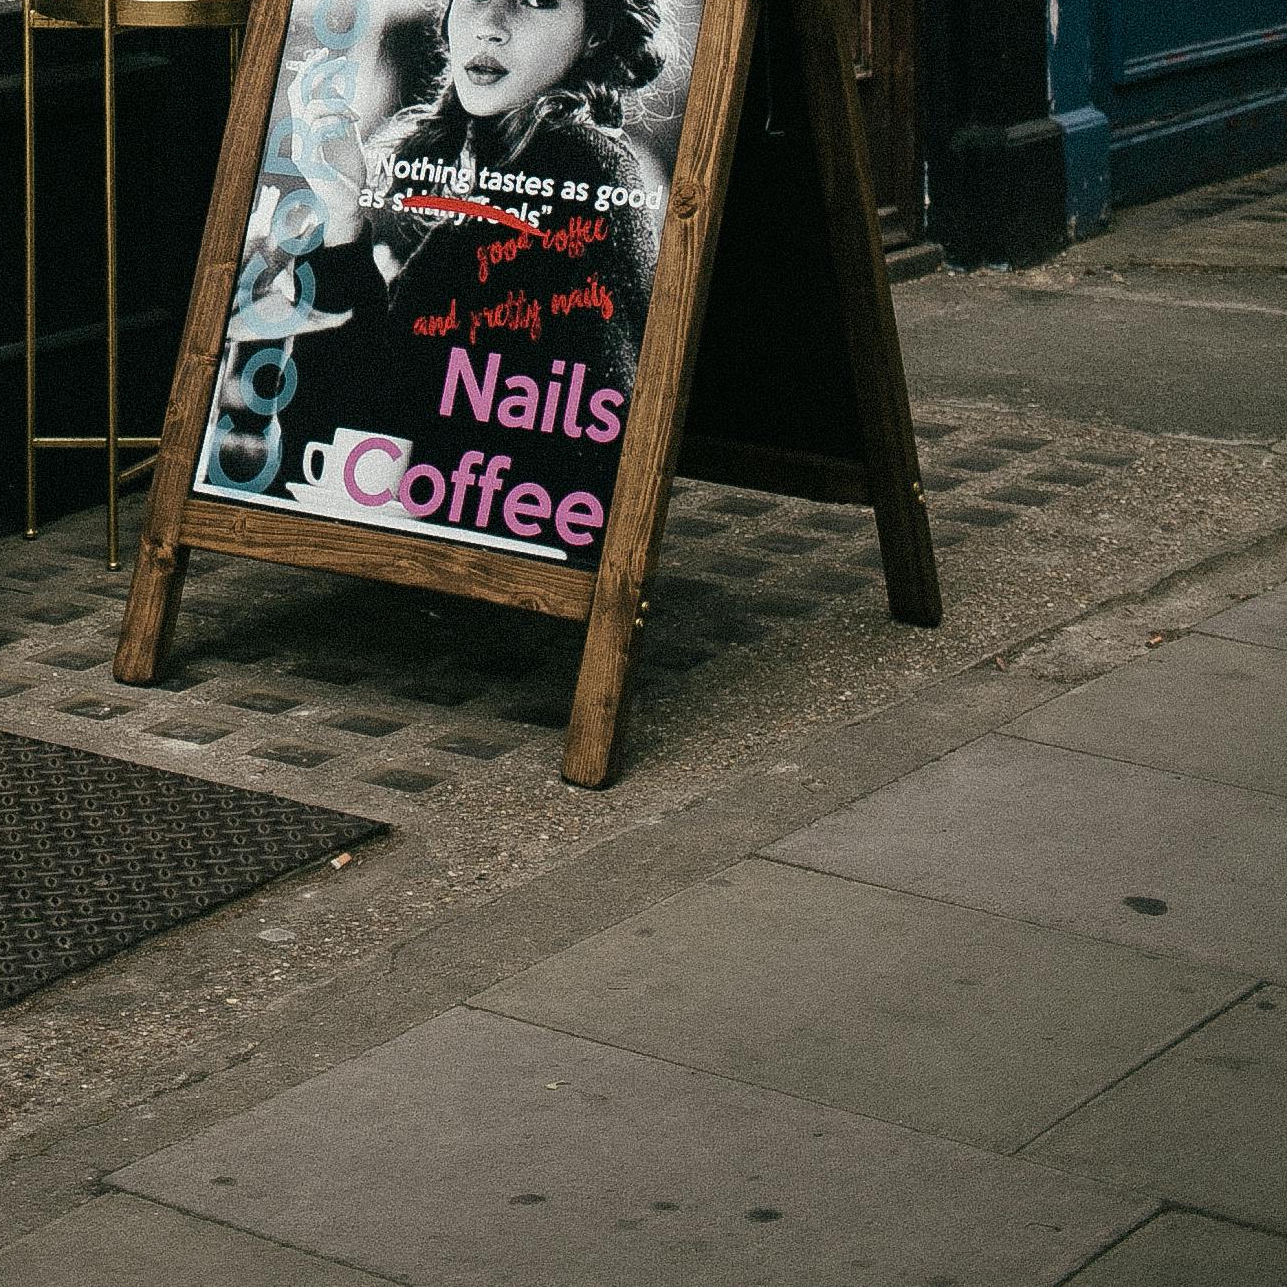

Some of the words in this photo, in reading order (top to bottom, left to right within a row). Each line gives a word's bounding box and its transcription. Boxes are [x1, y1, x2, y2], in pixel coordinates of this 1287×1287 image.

[358, 188, 385, 209] as
[479, 165, 555, 198] tastes
[560, 180, 589, 202] as
[594, 184, 664, 212] good
[476, 229, 533, 284] good
[542, 215, 609, 258] coffee
[413, 298, 460, 337] and
[470, 290, 542, 344] pretty
[551, 273, 614, 323] nails
[439, 346, 626, 444] Nails
[343, 436, 606, 547] Coffee
